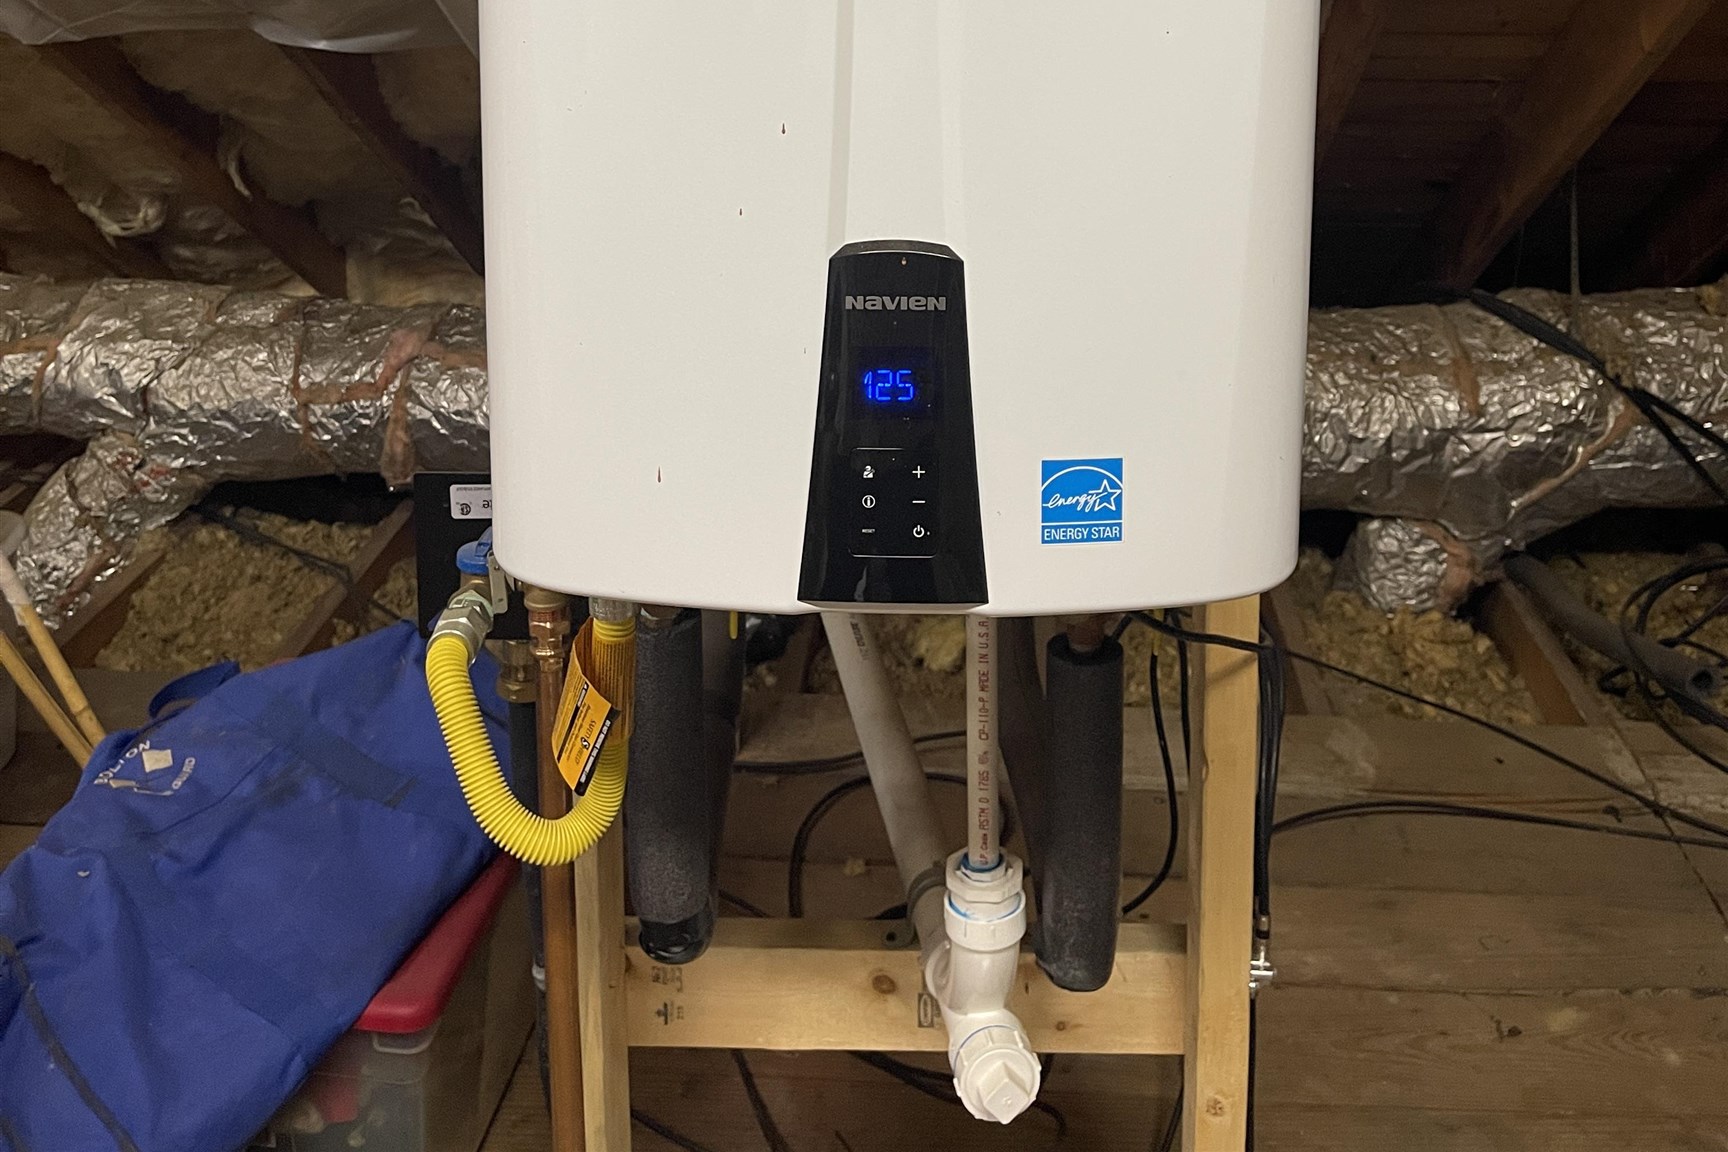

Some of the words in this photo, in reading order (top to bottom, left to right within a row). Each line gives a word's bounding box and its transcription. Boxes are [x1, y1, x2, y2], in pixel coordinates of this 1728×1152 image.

[864, 369, 914, 400] 125
[1046, 493, 1098, 513] energy
[1044, 527, 1089, 541] ENERGY
[1091, 526, 1120, 539] STAR
[978, 652, 989, 664] IN
[978, 670, 989, 694] MADE
[978, 808, 989, 831] ASTM
